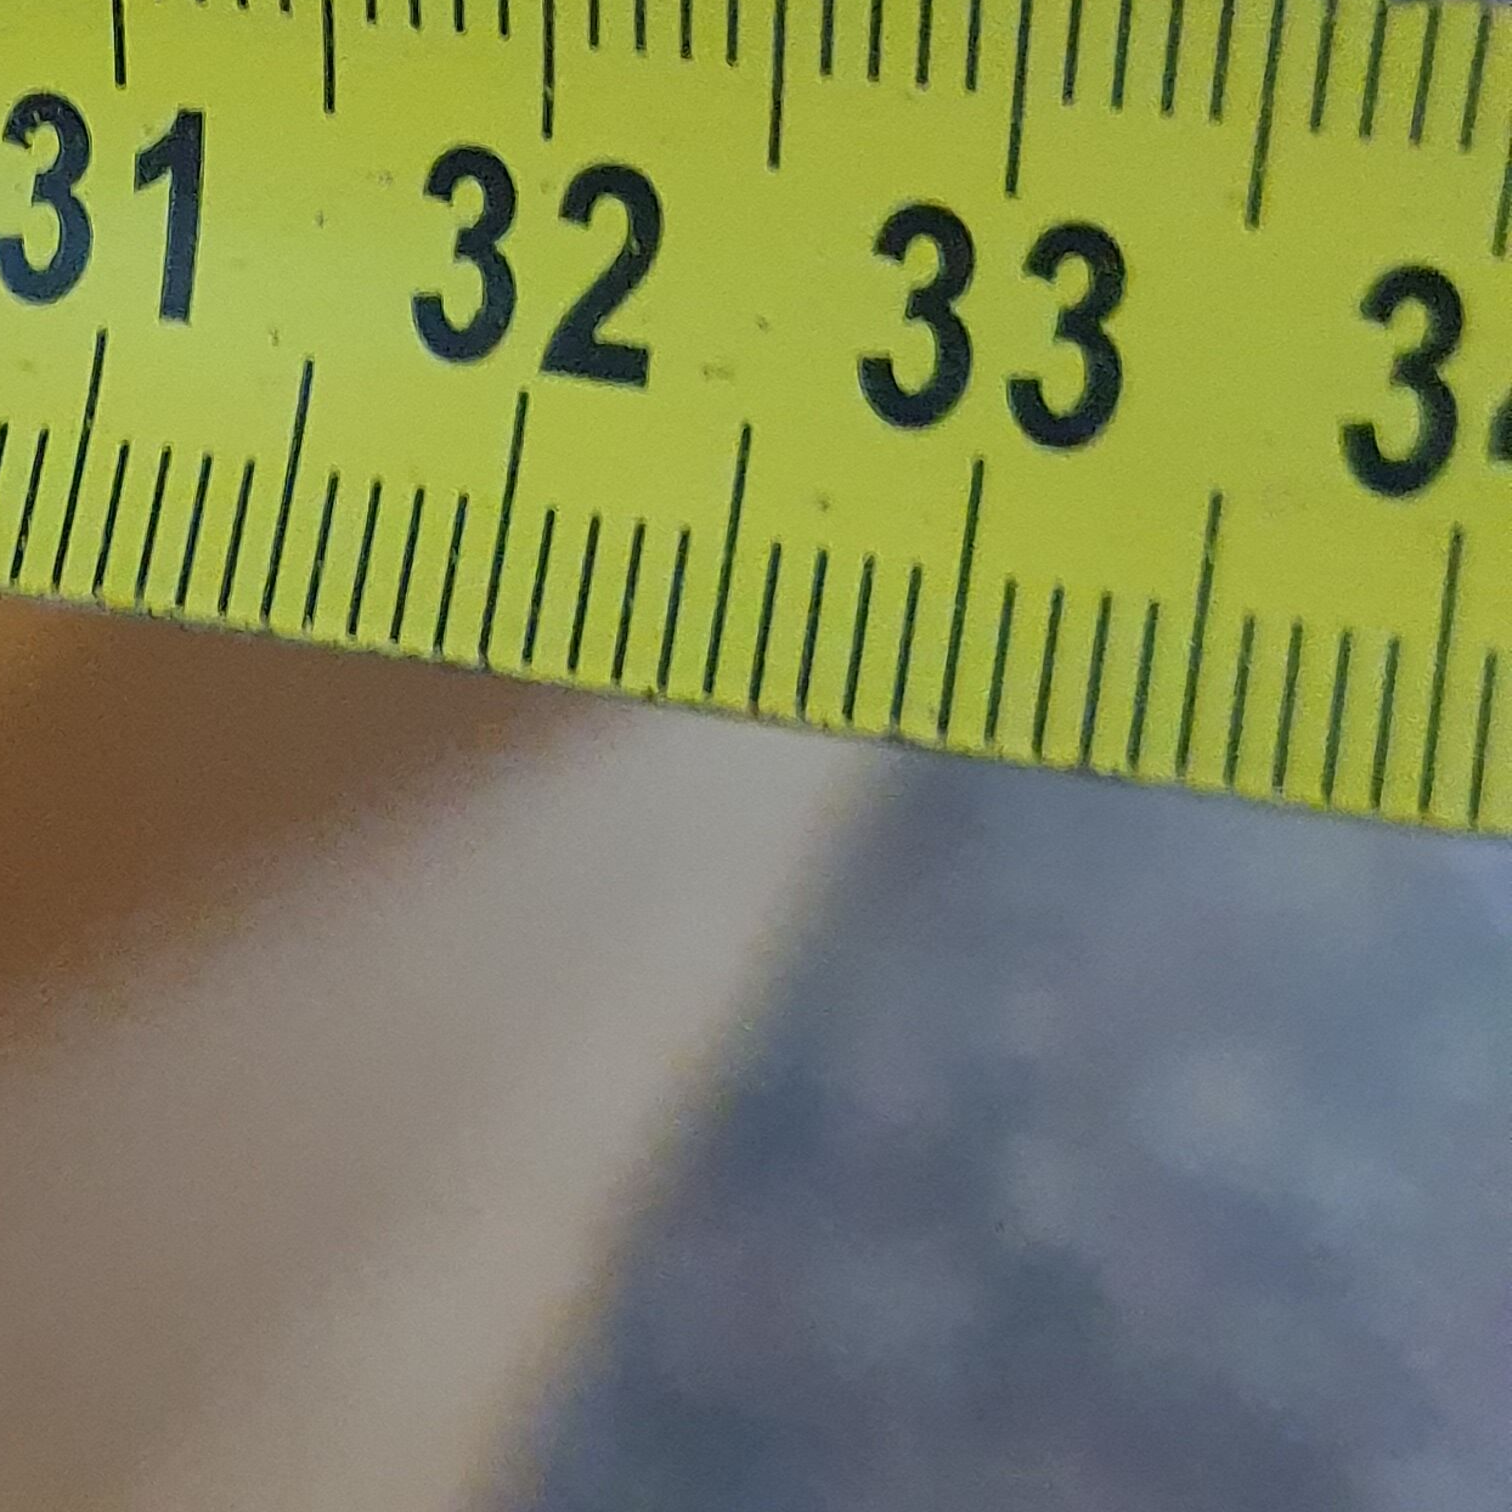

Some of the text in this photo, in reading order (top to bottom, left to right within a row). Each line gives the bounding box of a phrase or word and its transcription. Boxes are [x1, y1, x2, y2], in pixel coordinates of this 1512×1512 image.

[413, 145, 663, 387] 32
[858, 204, 1126, 450] 33
[1343, 265, 1512, 498] 3
